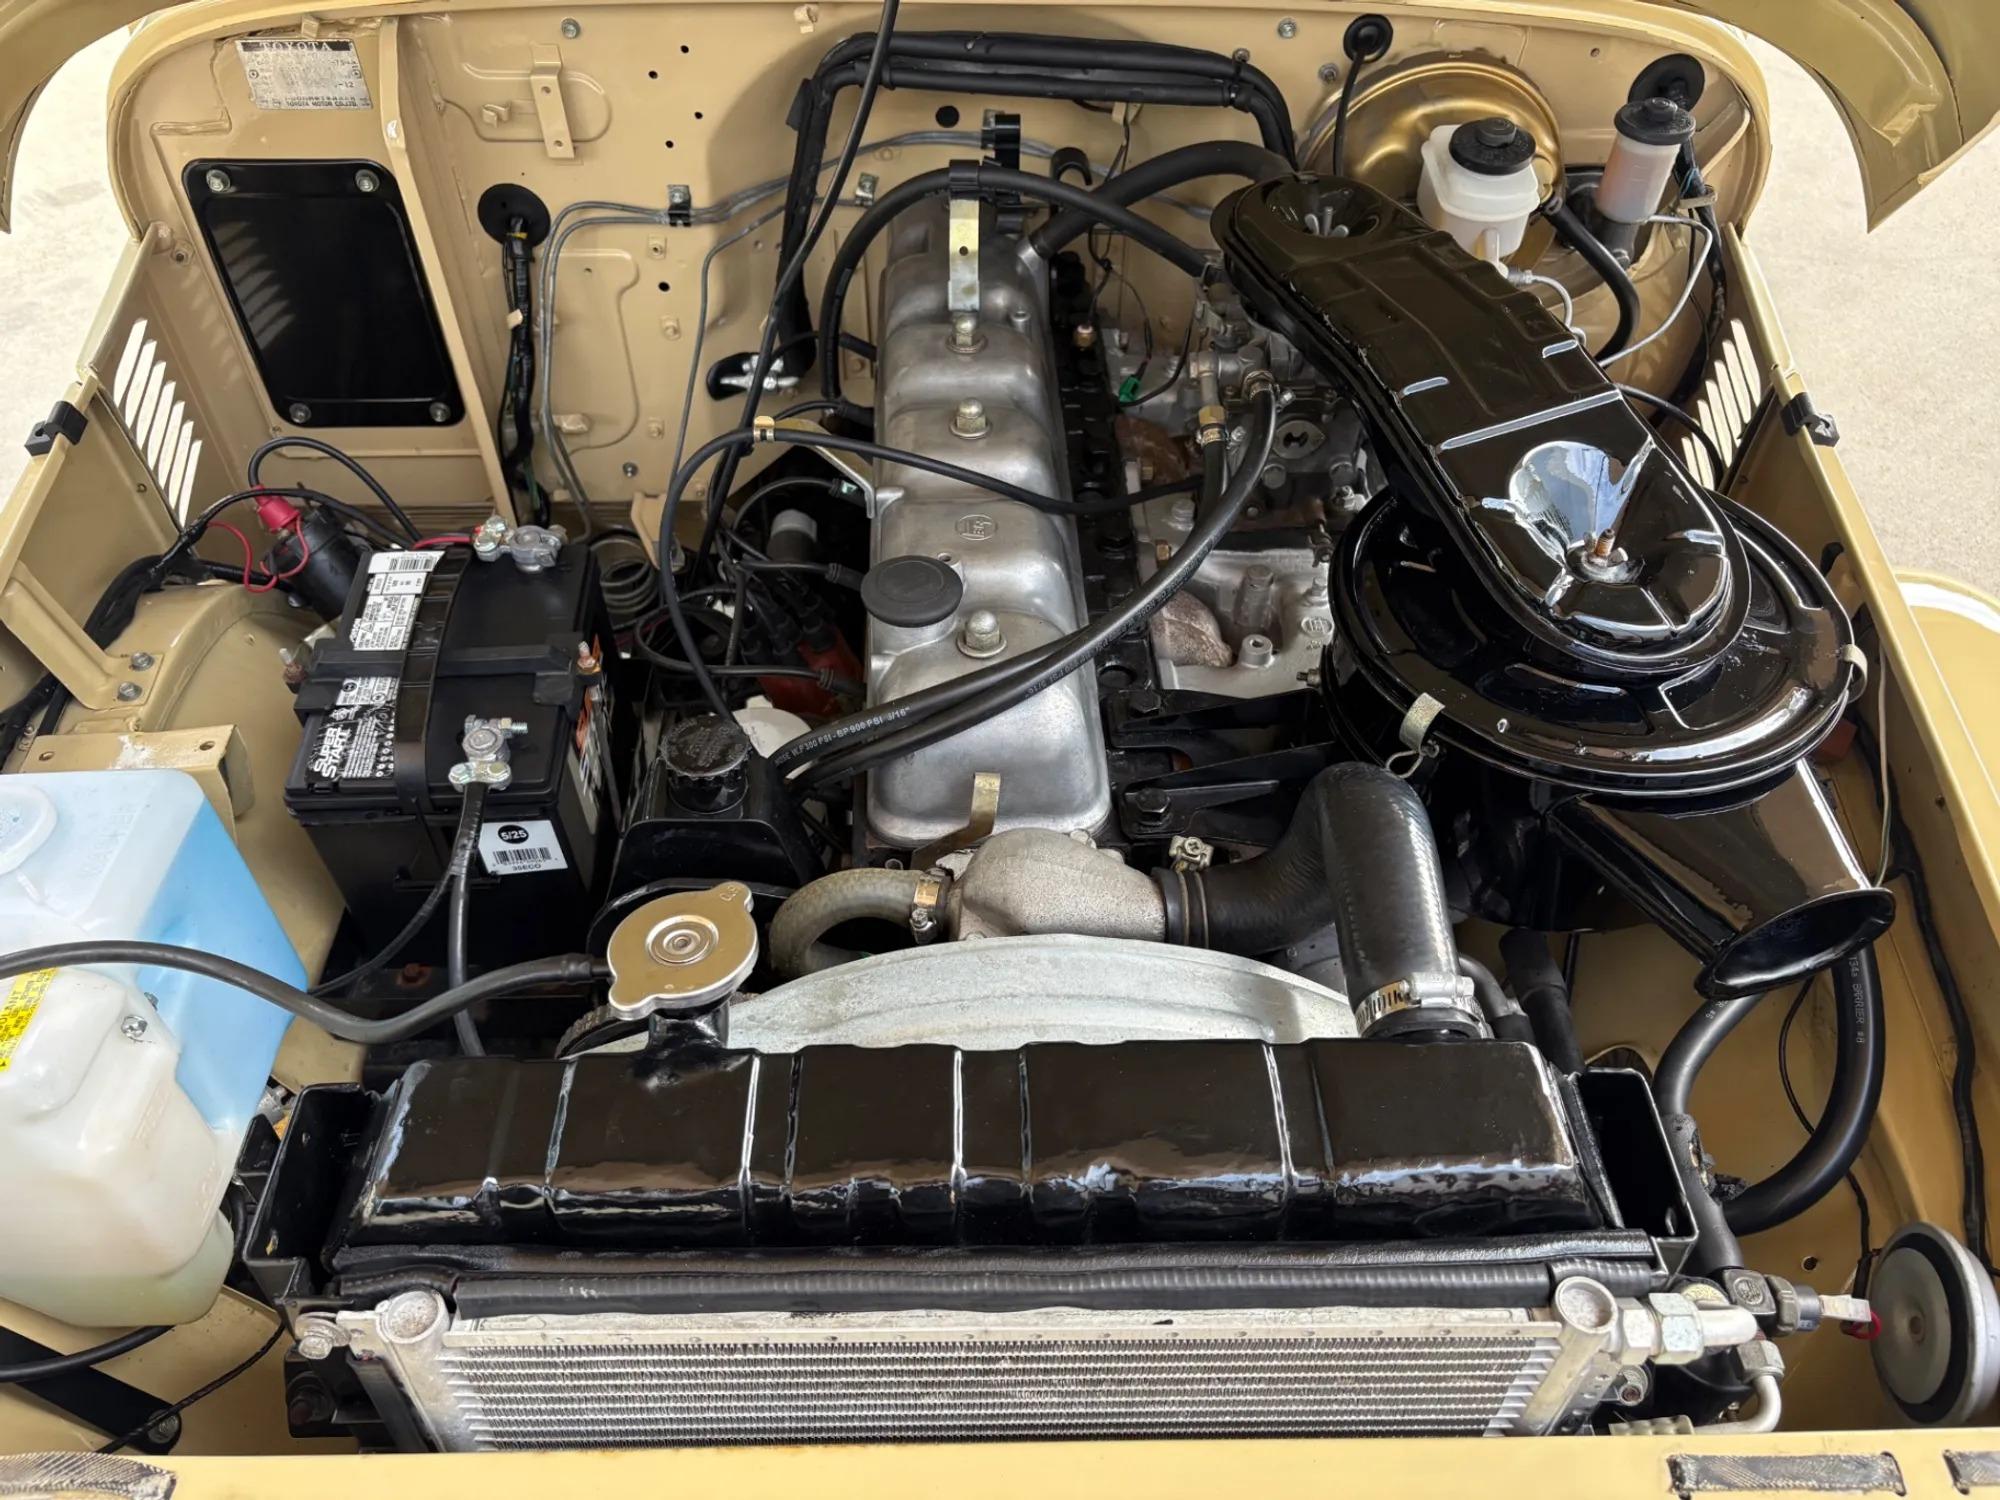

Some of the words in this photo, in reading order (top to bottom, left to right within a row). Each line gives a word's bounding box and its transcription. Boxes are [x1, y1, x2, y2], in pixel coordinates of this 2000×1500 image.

[259, 42, 333, 51] TOYOTA
[314, 727, 339, 772] SUPER
[322, 725, 352, 778] START
[501, 830, 527, 840] 5/25
[1852, 983, 1865, 1024] BARRIER
